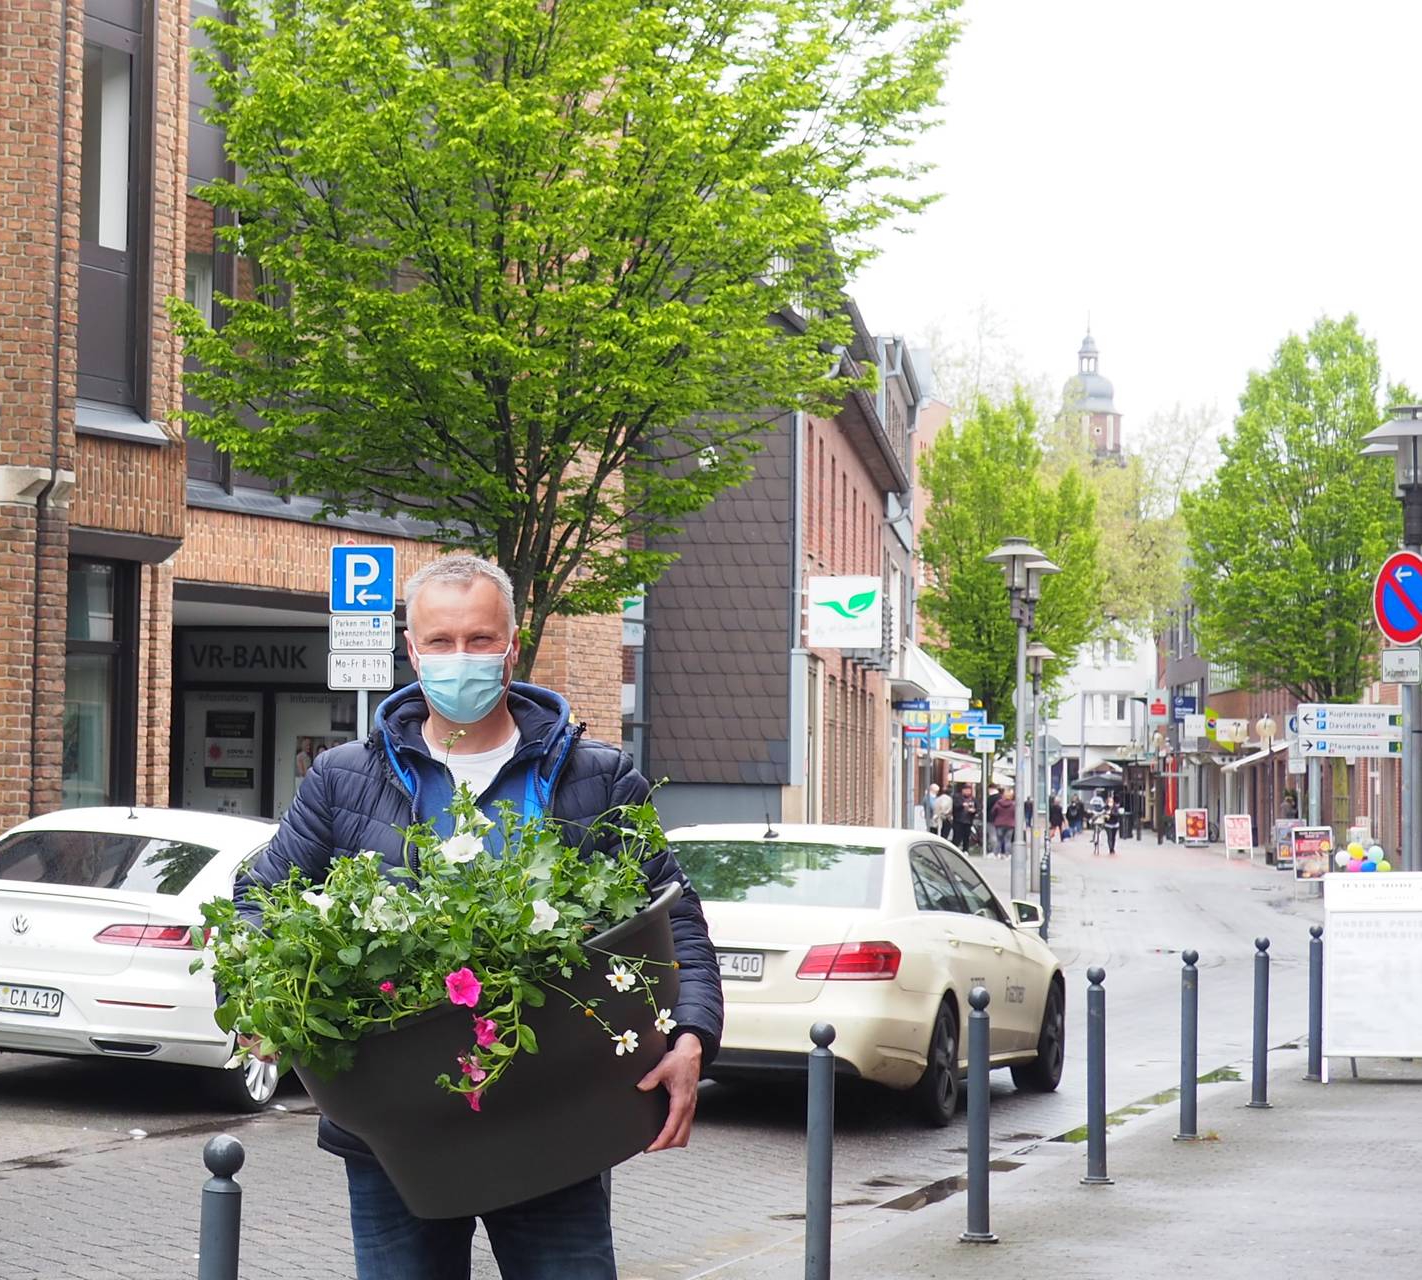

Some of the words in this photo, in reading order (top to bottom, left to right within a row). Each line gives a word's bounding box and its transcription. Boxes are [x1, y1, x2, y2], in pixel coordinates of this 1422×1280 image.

[346, 554, 380, 604] P
[336, 619, 357, 627] Parken
[360, 619, 370, 627] mit
[334, 630, 390, 638] gekennzeichneten
[340, 638, 364, 646] Flächen
[189, 645, 308, 669] VR-BANK
[336, 660, 359, 668] Mo-Fr
[342, 674, 352, 683] Sa
[1329, 710, 1385, 719] Kupferpassage
[1329, 721, 1376, 729] Davidstraße
[1329, 743, 1379, 751] Pfauengasse
[731, 956, 759, 973] 400
[10, 989, 27, 1006] CA
[33, 991, 60, 1009] 419
